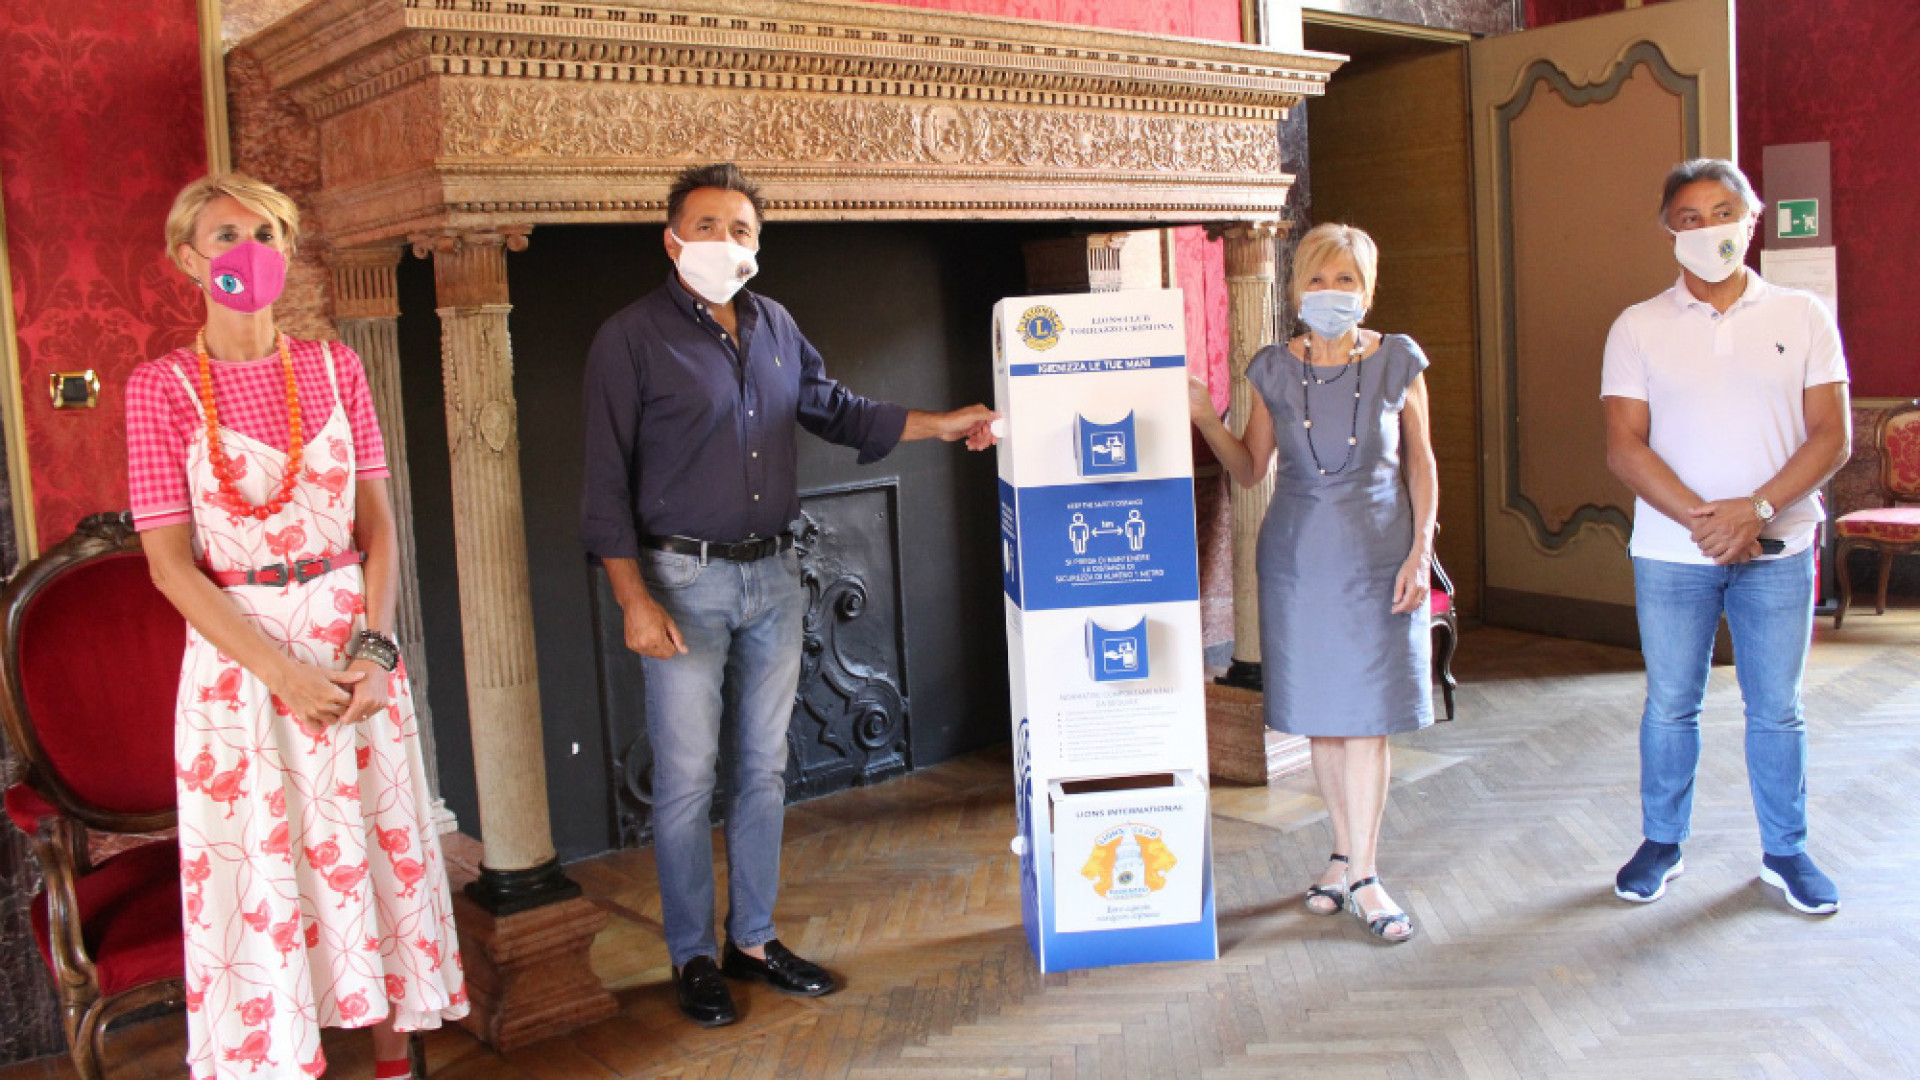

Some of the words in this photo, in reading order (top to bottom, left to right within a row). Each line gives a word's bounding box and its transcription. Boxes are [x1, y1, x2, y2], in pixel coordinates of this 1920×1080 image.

[1034, 319, 1049, 336] L
[1038, 361, 1087, 374] IGIENIZZA
[1088, 360, 1101, 371] LE
[1103, 359, 1124, 369] TUE
[1125, 358, 1151, 367] MANI
[1076, 808, 1105, 818] LIONS
[1107, 804, 1183, 816] INTERNATIONAL
